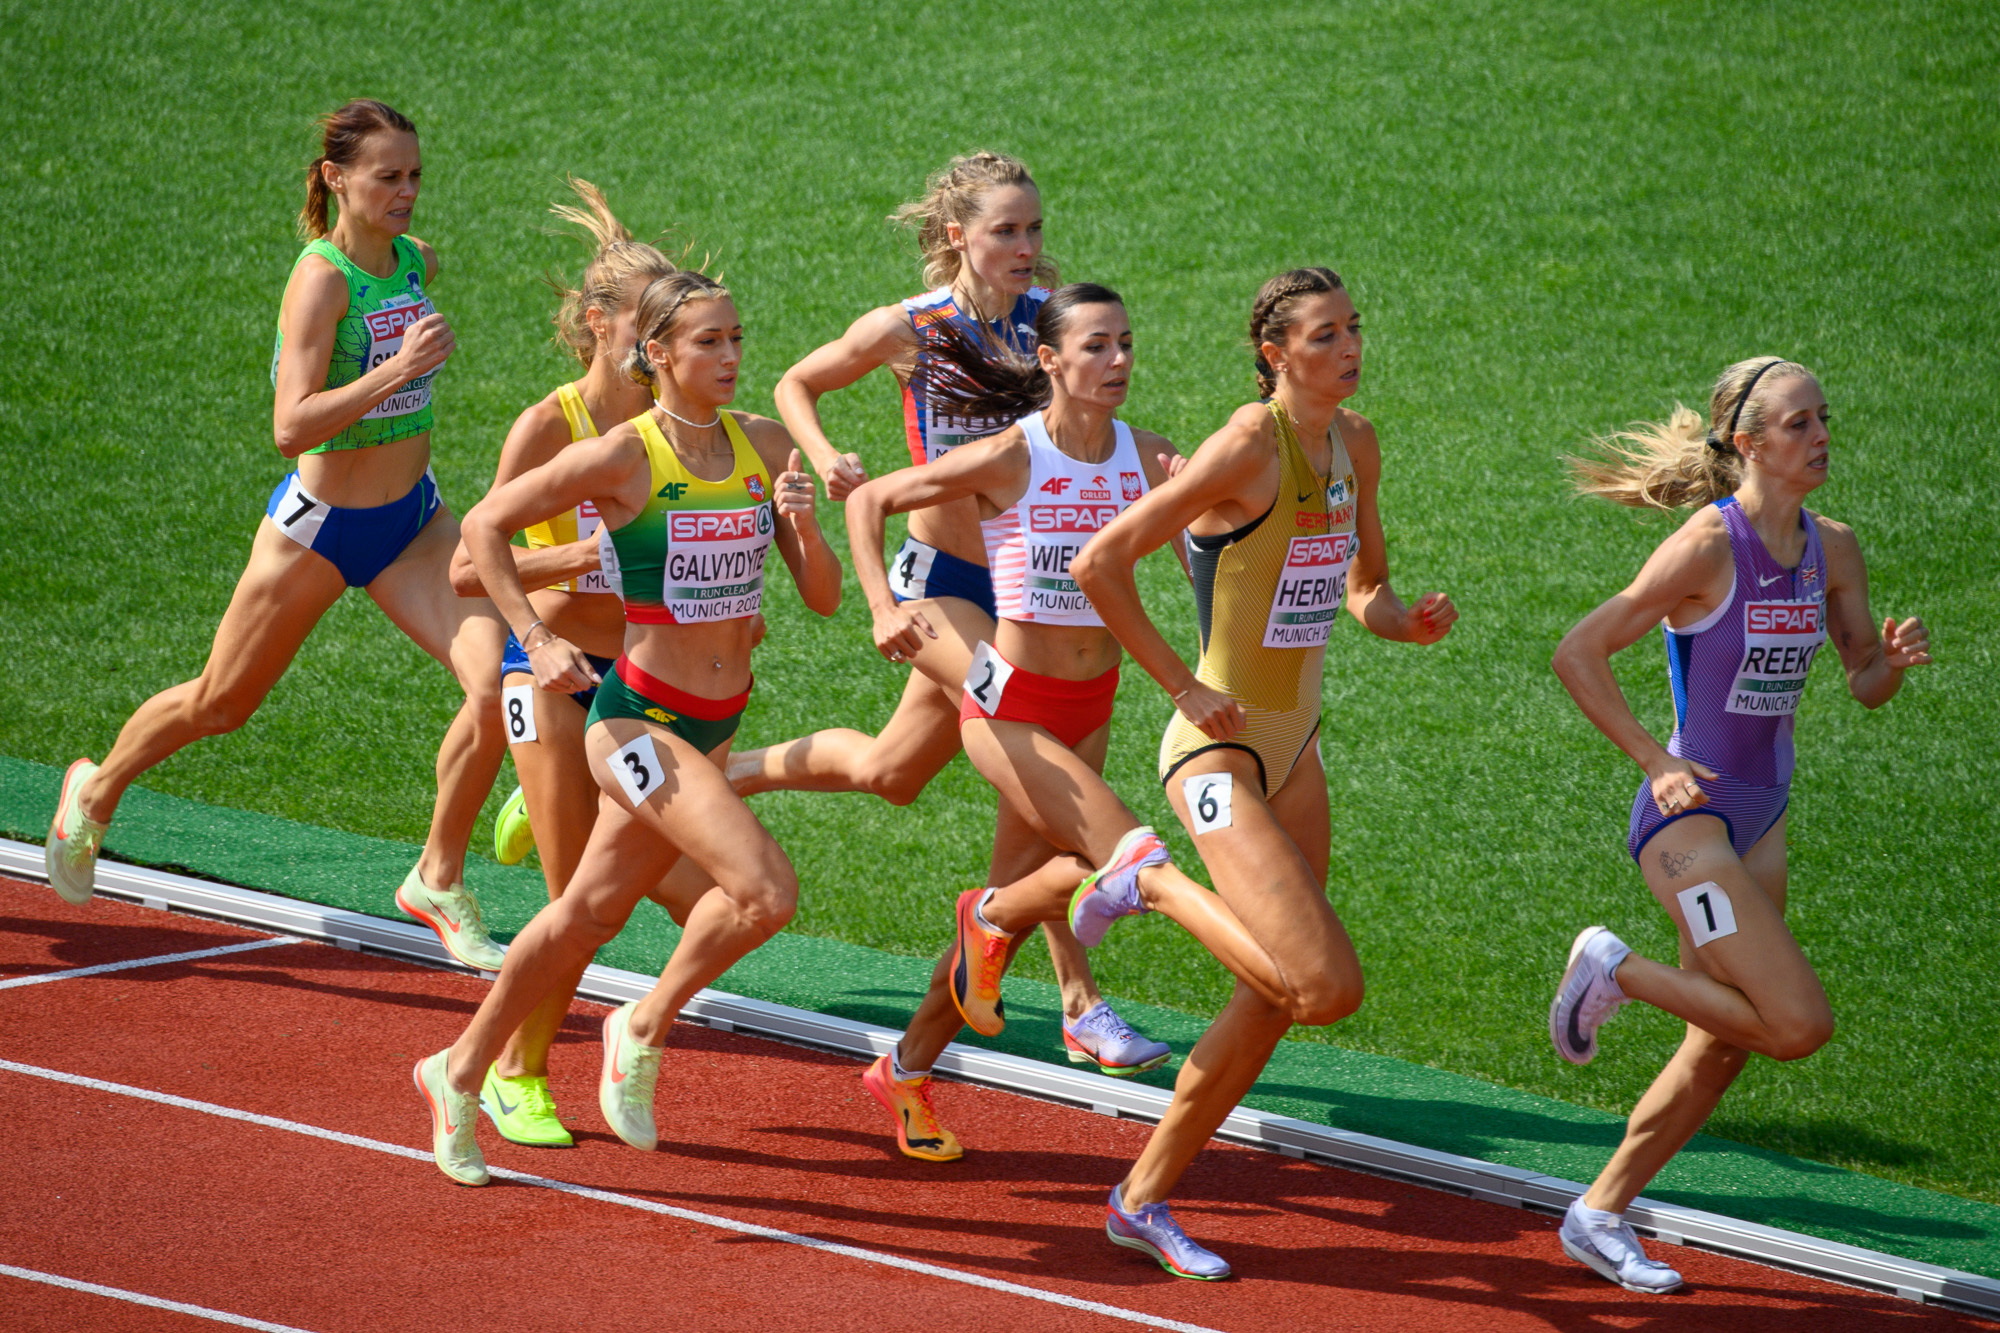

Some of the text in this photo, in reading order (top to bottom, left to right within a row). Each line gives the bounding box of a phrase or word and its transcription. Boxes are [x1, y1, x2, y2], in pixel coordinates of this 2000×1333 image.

[657, 482, 688, 501] 4F
[1040, 477, 1072, 495] 4F
[1081, 491, 1110, 499] ORLEN
[283, 491, 317, 528] 7
[1295, 503, 1355, 529] GERMANY
[674, 514, 754, 538] SPAR
[669, 543, 769, 582] GALVYDYTE
[1290, 540, 1348, 564] SPAR
[900, 551, 918, 588] 4
[700, 587, 721, 599] RUN
[1278, 571, 1347, 607] HERING
[672, 601, 731, 618] MUNICH
[1298, 610, 1315, 623] RUN
[1750, 608, 1818, 630] SPAR
[1271, 625, 1320, 643] MUNICH
[973, 660, 996, 704] 2
[1765, 681, 1783, 691] RUN
[1735, 693, 1789, 711] MUNICH
[508, 698, 526, 738] 8
[644, 707, 678, 723] 4F
[623, 752, 650, 791] 3
[1198, 783, 1218, 823] 6
[1696, 892, 1717, 933] 1
